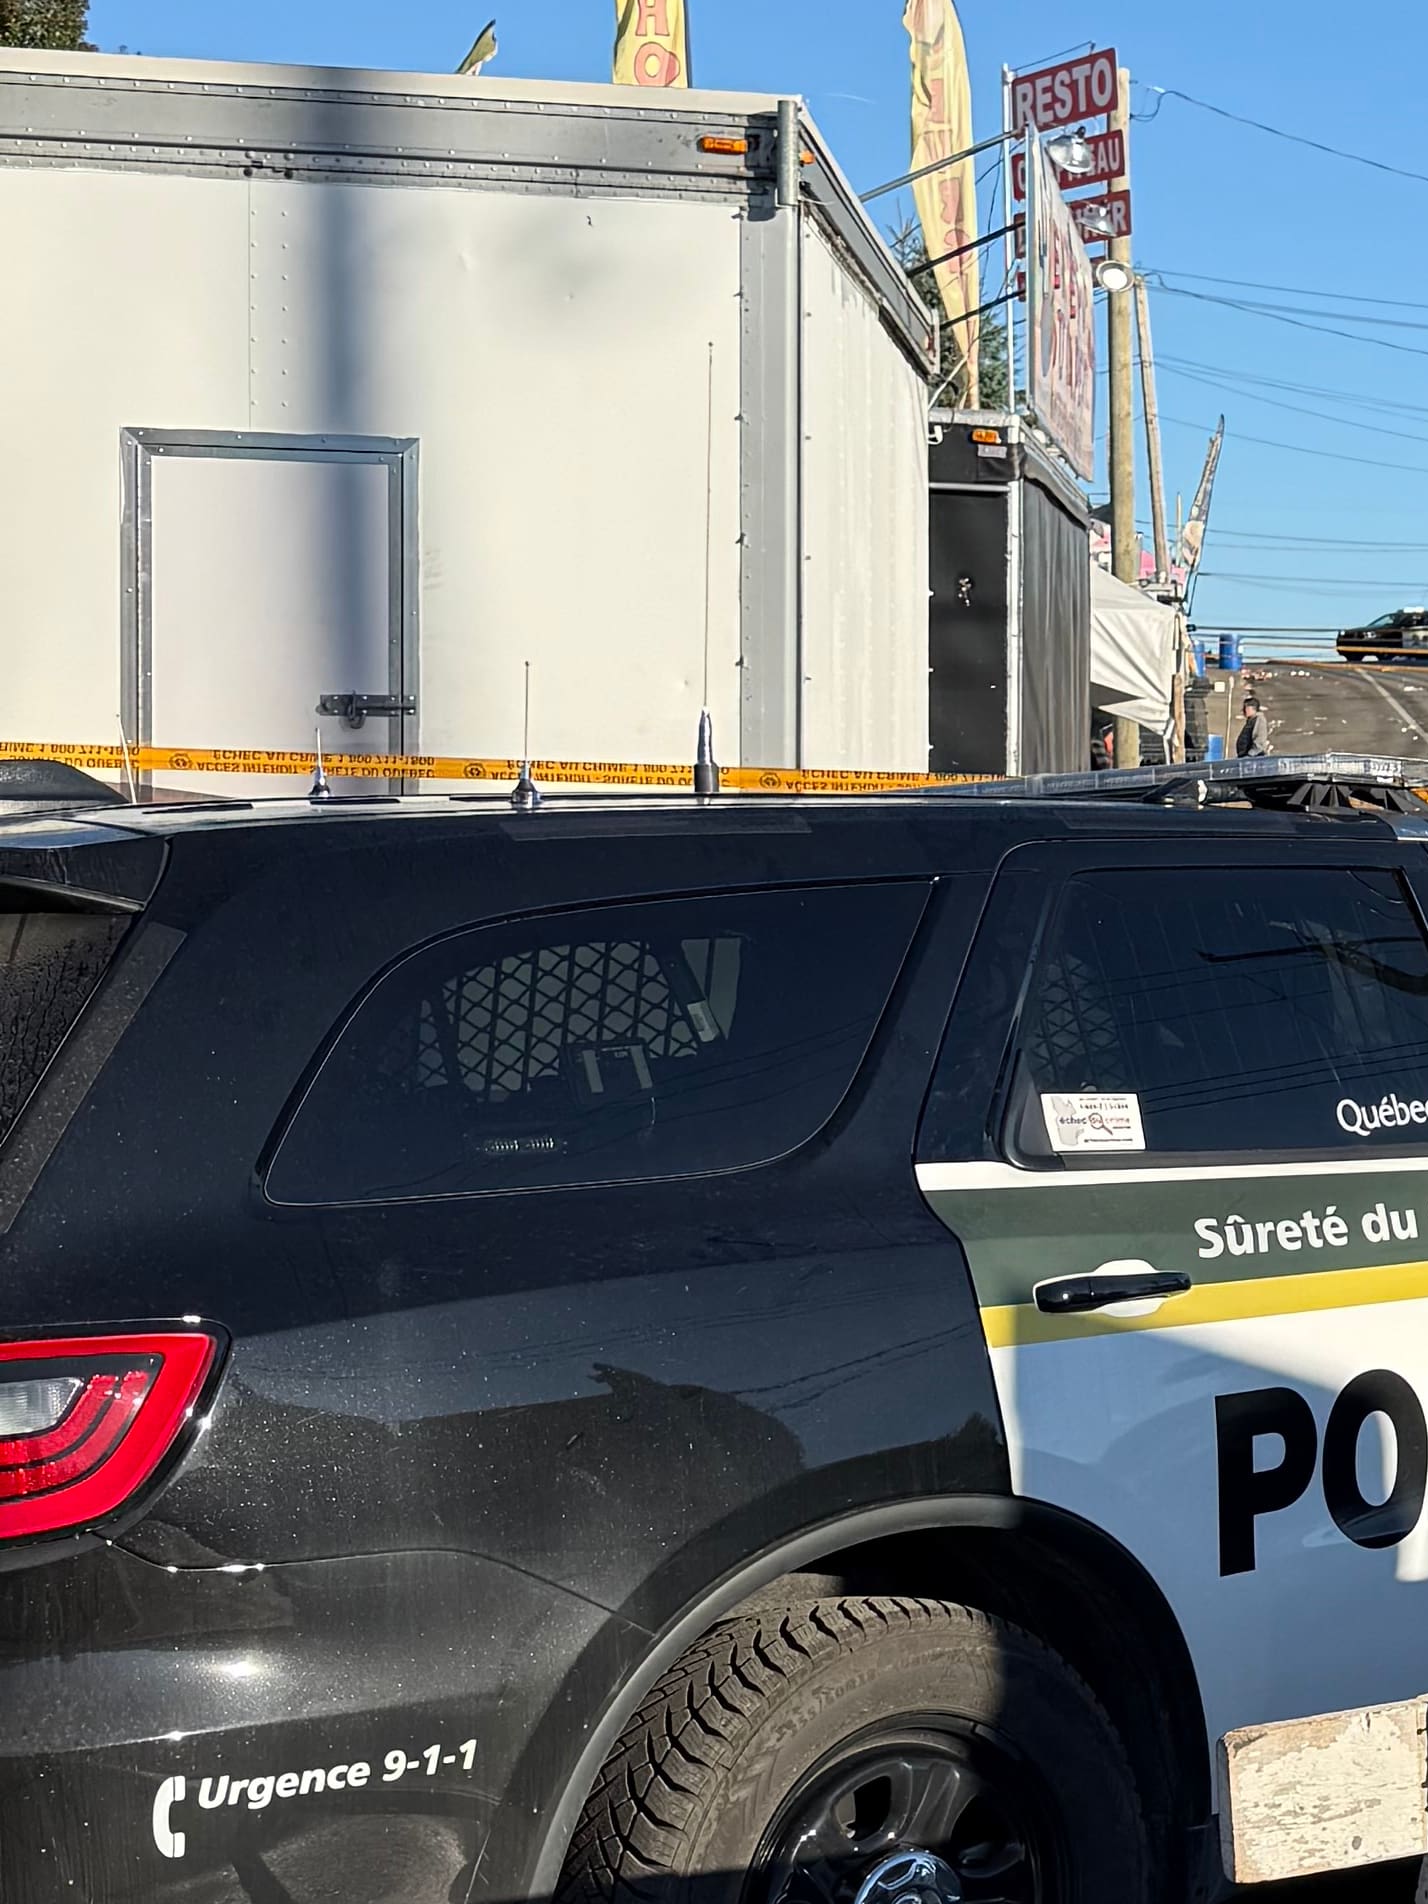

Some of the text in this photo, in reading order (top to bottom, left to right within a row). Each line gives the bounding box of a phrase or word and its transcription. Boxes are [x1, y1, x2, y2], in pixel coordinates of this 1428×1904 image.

[1016, 57, 1112, 129] RESTO
[1193, 1205, 1349, 1259] Sûreté
[1361, 1203, 1419, 1243] du
[198, 1739, 477, 1810] Urgence 9-1-1
